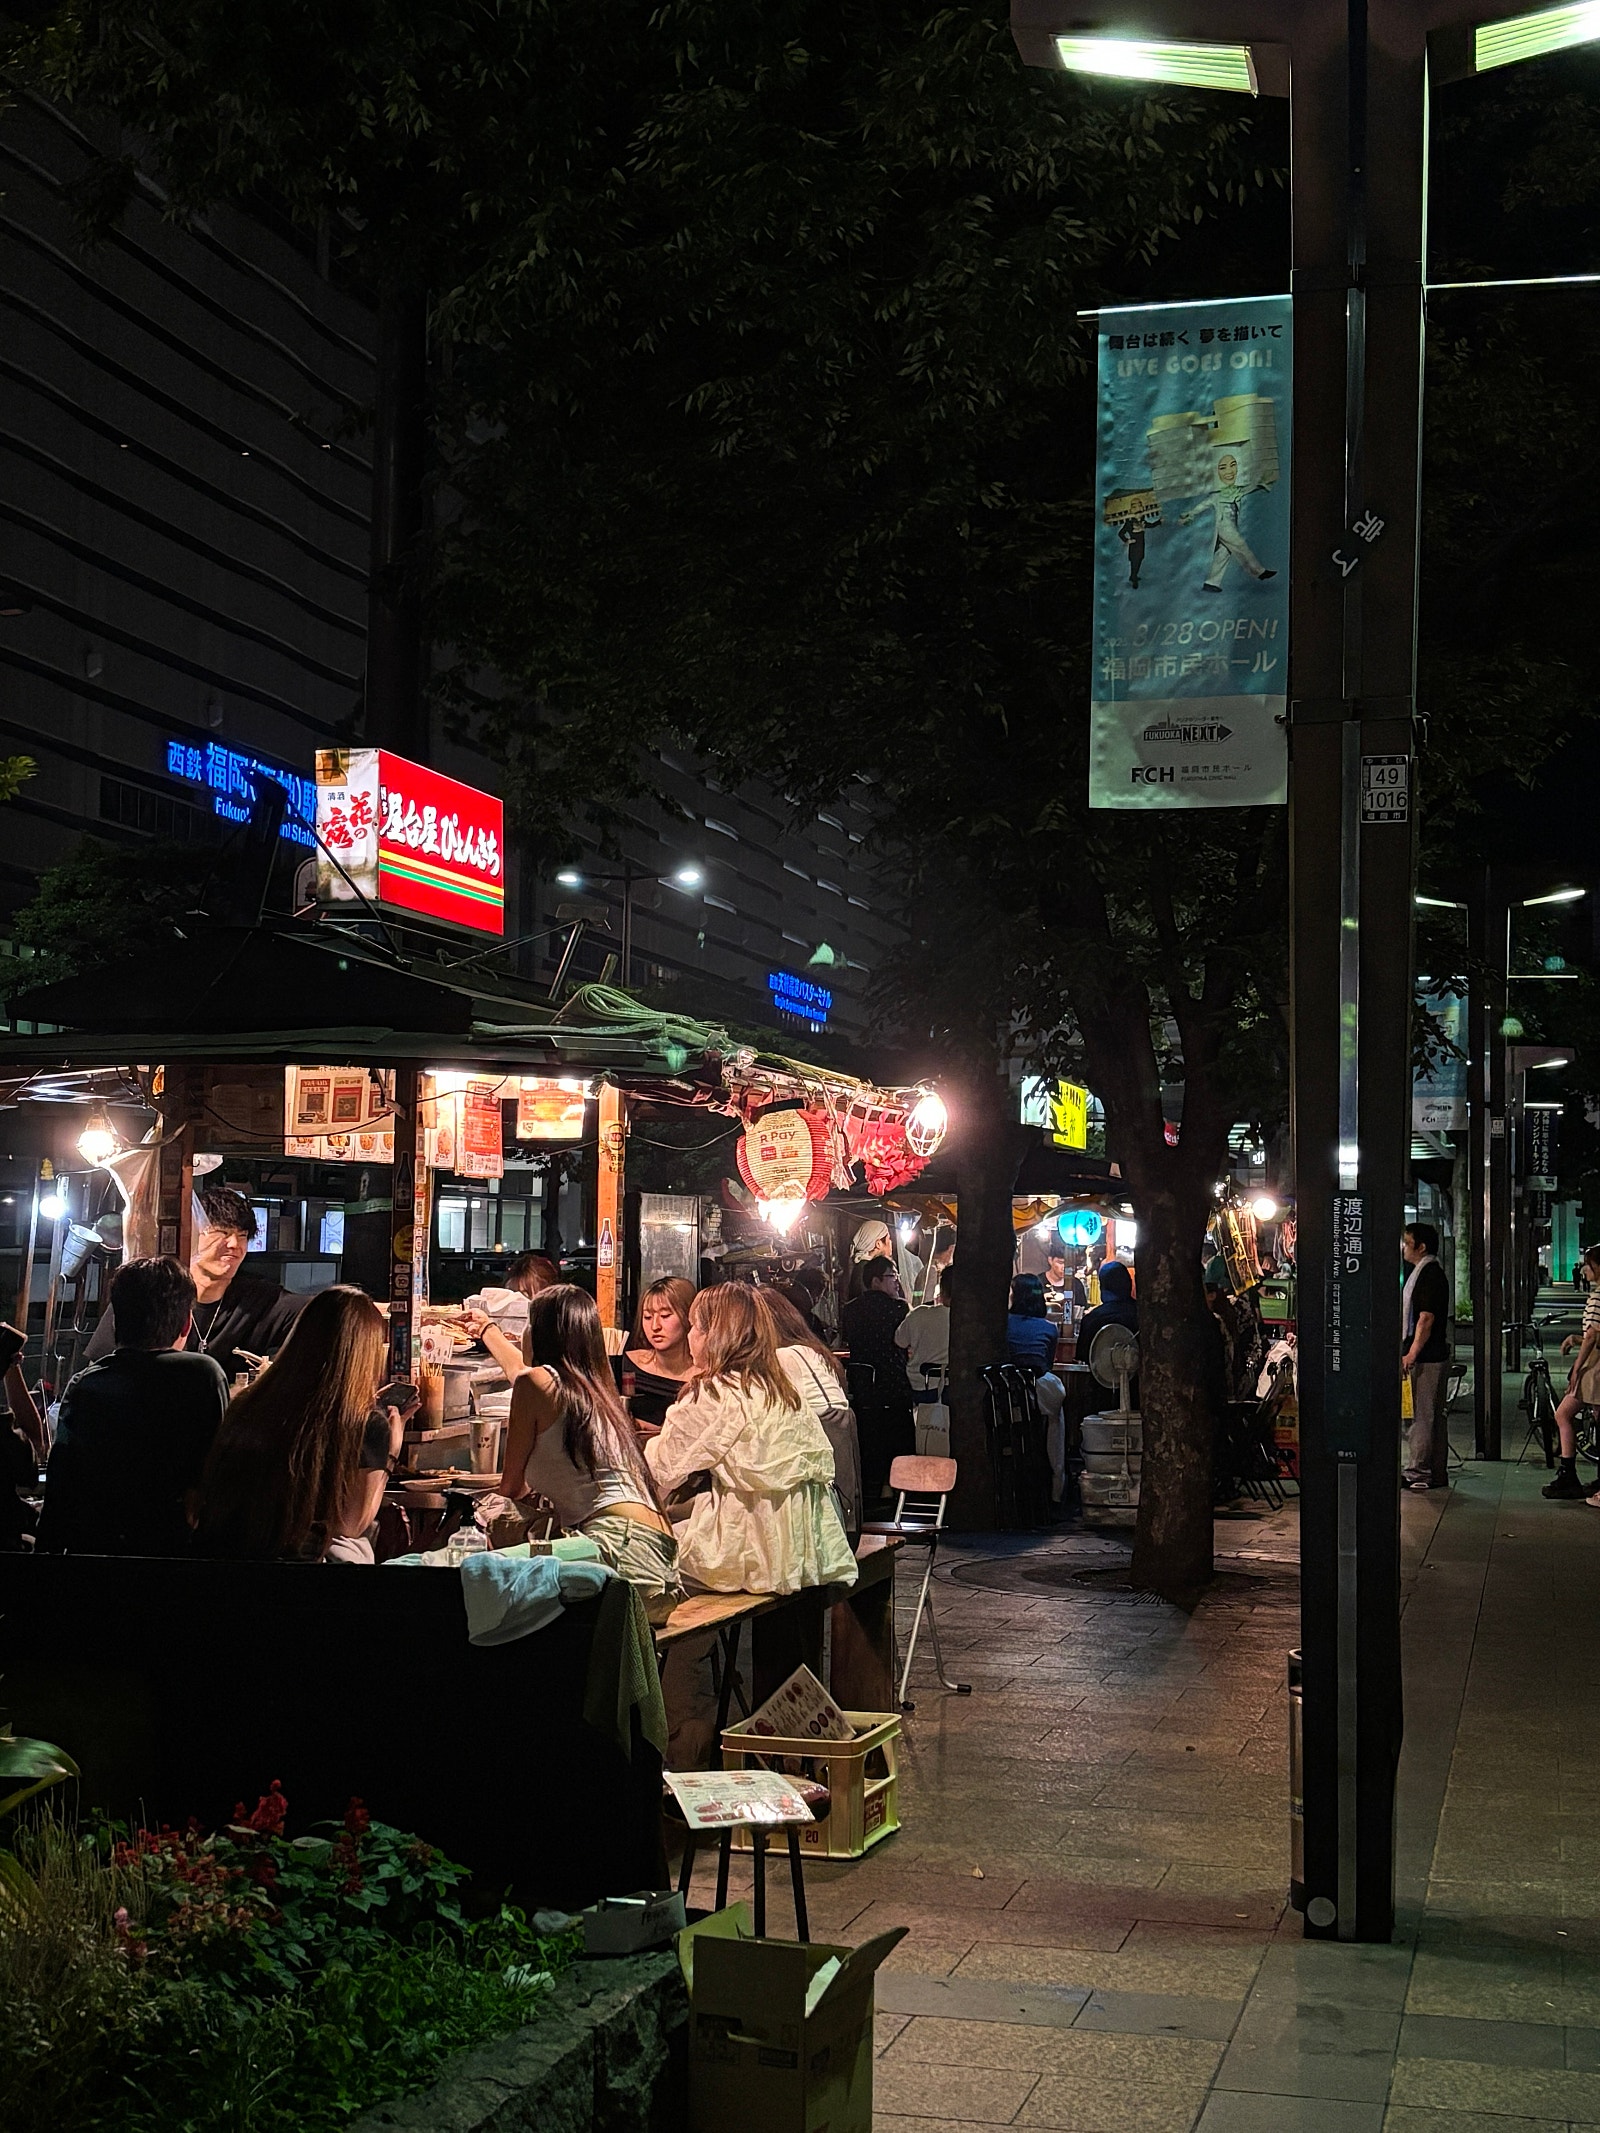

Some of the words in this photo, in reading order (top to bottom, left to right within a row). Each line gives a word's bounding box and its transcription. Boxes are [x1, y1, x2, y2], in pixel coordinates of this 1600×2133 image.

[1109, 330, 1189, 350] 舞台は続く
[1200, 324, 1283, 344] 夢を描いて
[1117, 357, 1159, 377] LIVE
[1165, 352, 1223, 374] GOES
[1229, 349, 1273, 370] ON!
[1198, 618, 1279, 643] OPEN!
[1102, 649, 1278, 681] 福岡市民ホール
[1144, 730, 1180, 740] FUKUOKA
[1182, 724, 1218, 742] NEXT
[168, 741, 202, 781] 西鉄
[1131, 766, 1175, 783] FCH
[1375, 768, 1399, 785] 49
[1367, 791, 1407, 808] 1016
[380, 792, 501, 878] 屋台屋ぴょんきち
[770, 1130, 797, 1142] Pay
[1333, 1198, 1342, 1258] Watanabe-dori
[1343, 1197, 1363, 1274] 渡辺通り
[1333, 1260, 1341, 1279] Ave.
[805, 1829, 819, 1843] 20
